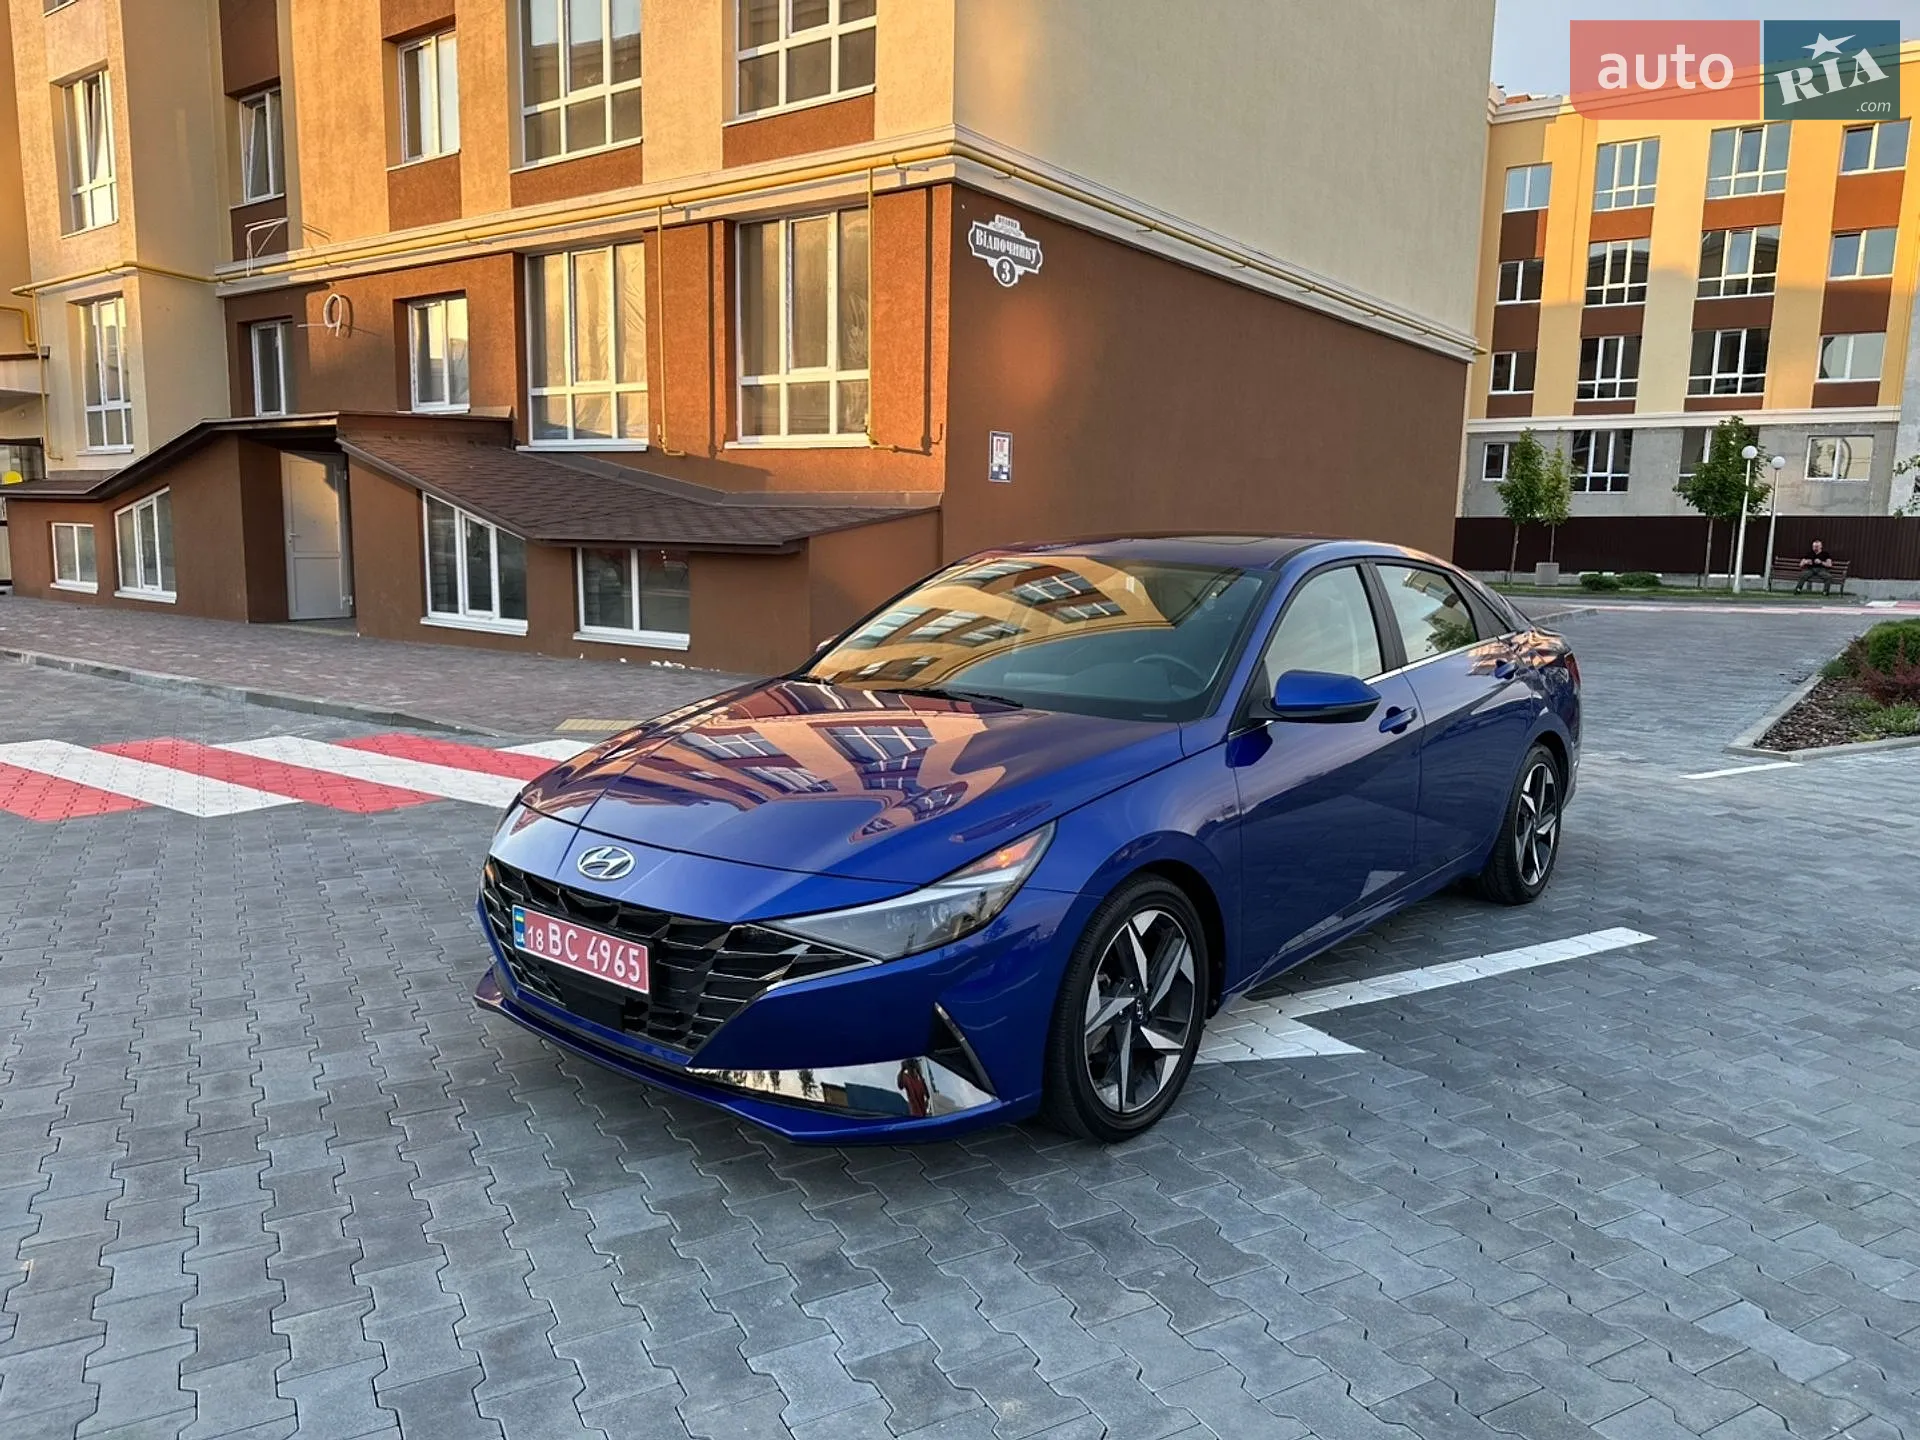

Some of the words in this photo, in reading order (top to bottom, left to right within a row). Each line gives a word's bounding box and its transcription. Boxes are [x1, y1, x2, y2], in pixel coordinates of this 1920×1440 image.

[1001, 261, 1011, 282] 3
[527, 925, 544, 951] 18
[548, 922, 578, 962] BC
[586, 935, 640, 983] 4965
